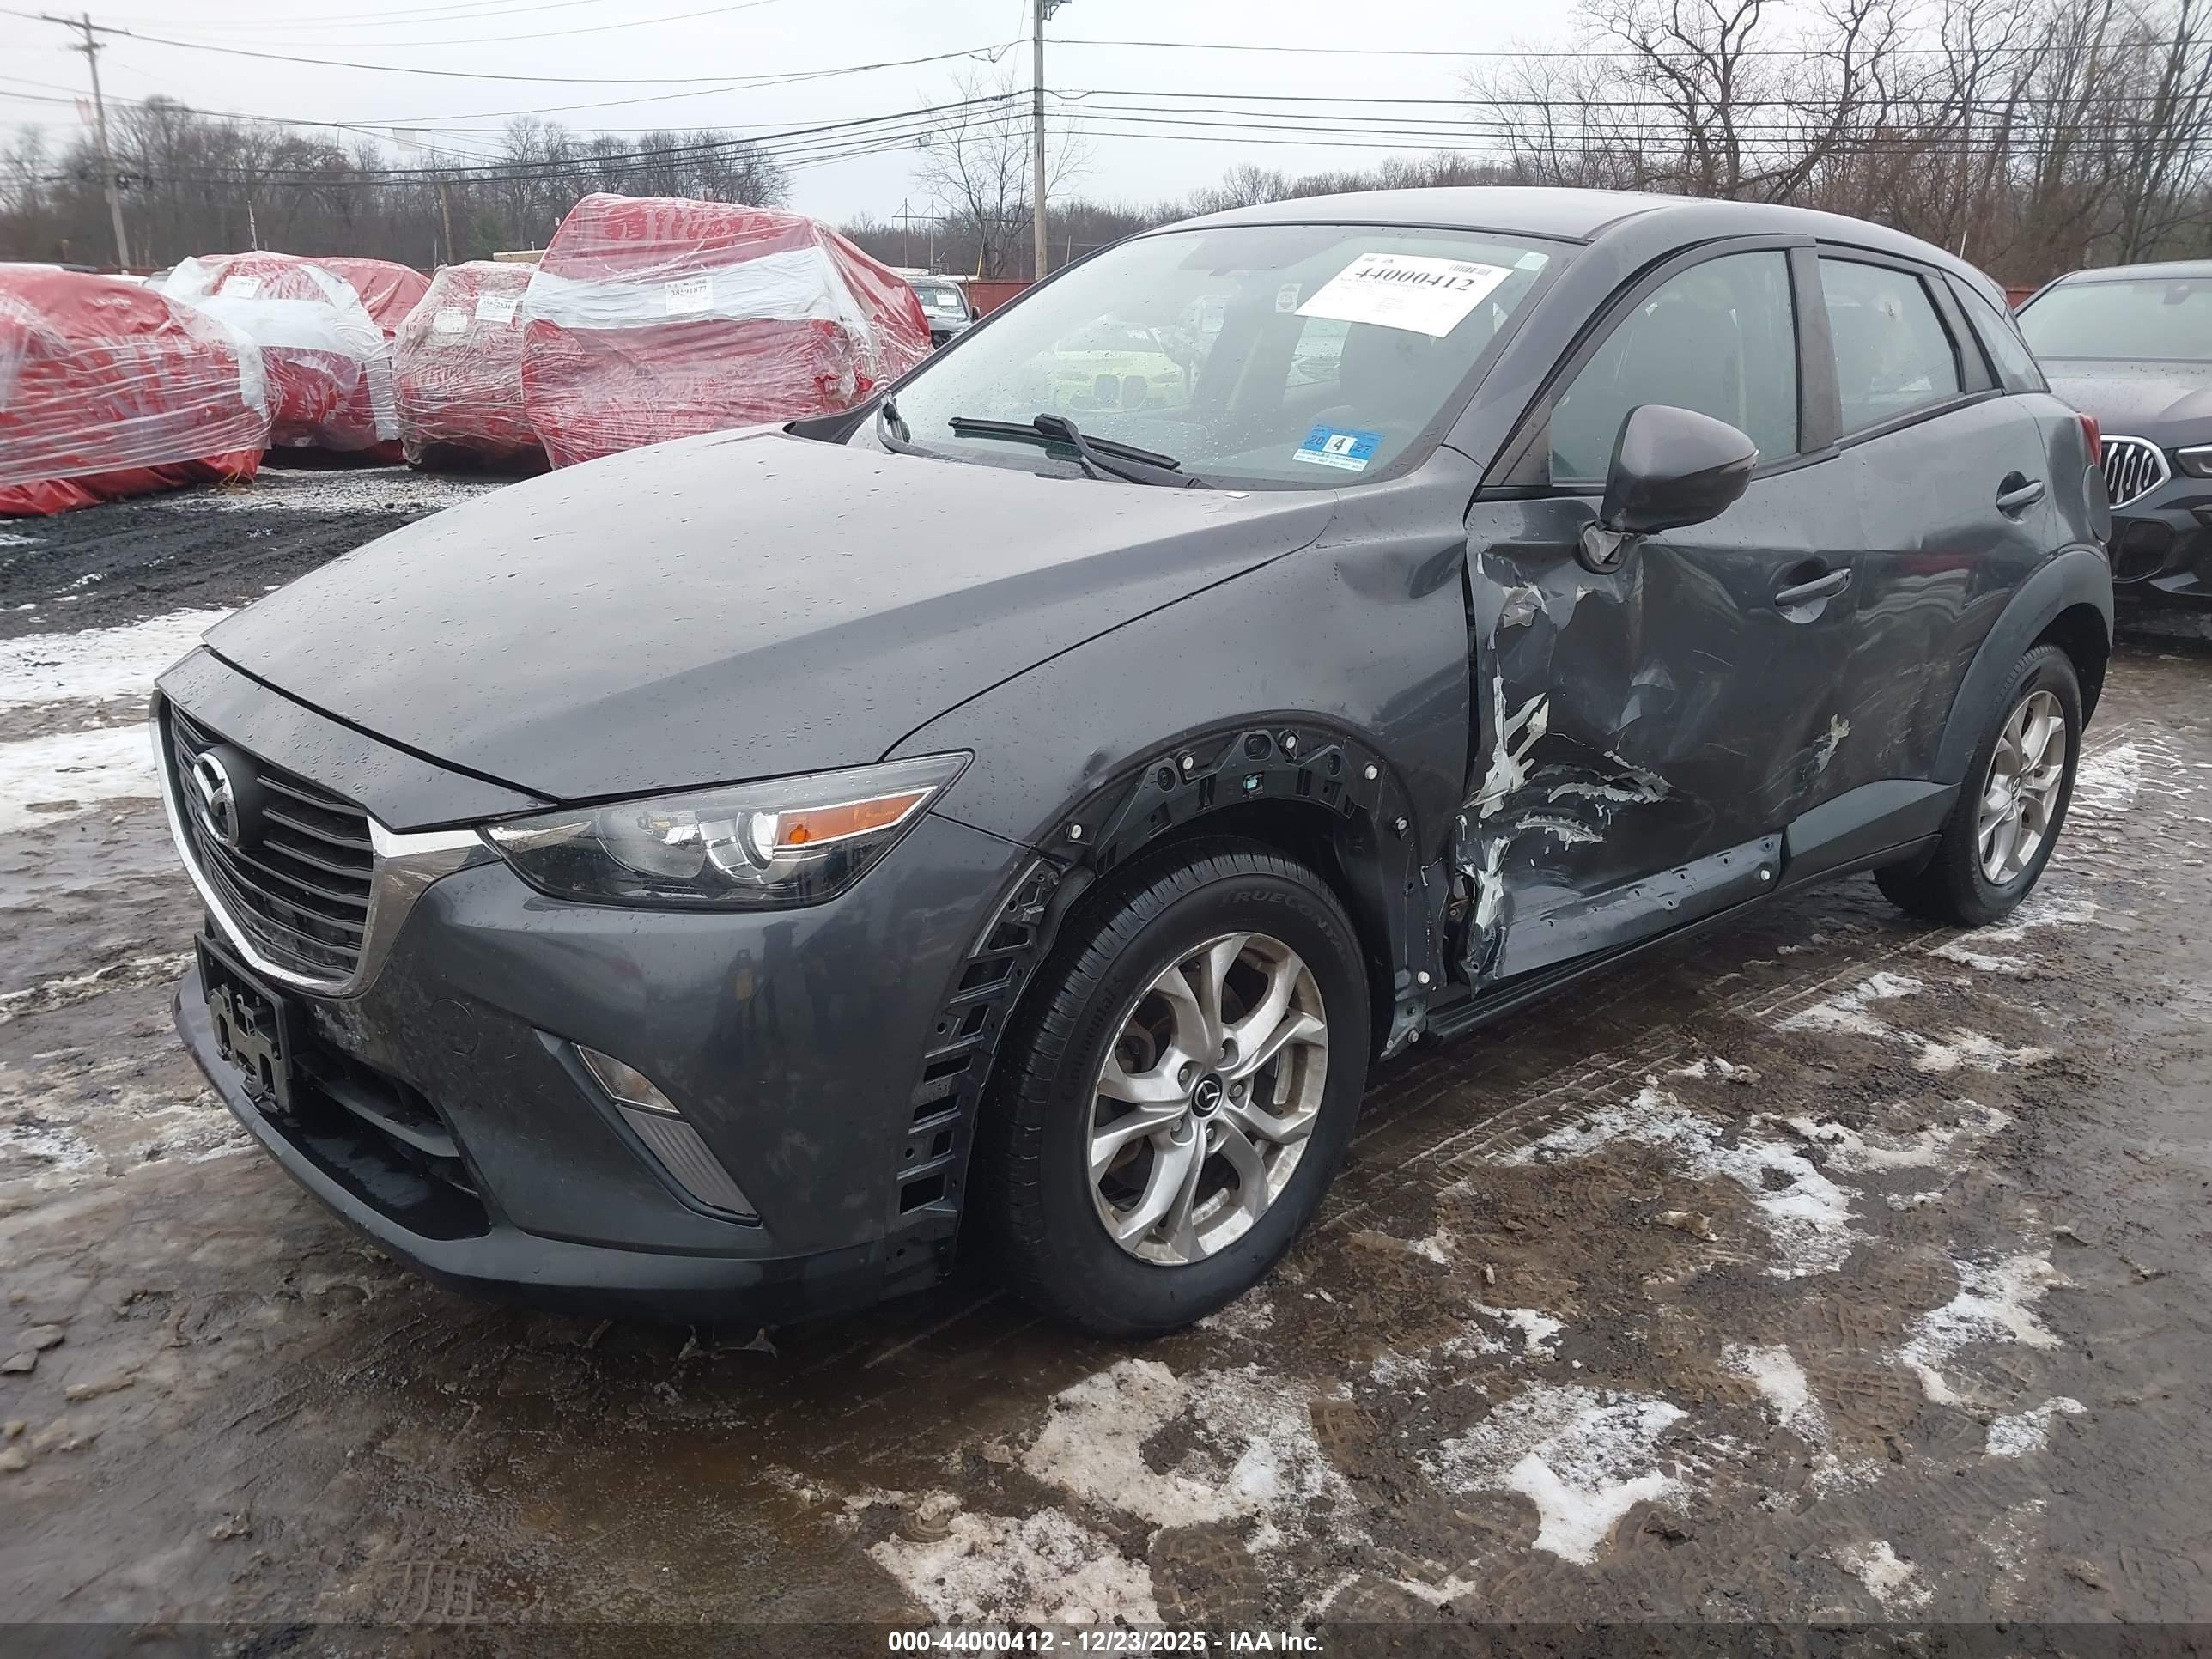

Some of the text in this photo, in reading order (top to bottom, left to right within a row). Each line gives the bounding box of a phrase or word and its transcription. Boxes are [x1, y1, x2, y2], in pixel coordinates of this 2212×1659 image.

[1355, 267, 1475, 291] 44000412
[1306, 434, 1373, 454] 20 4 27
